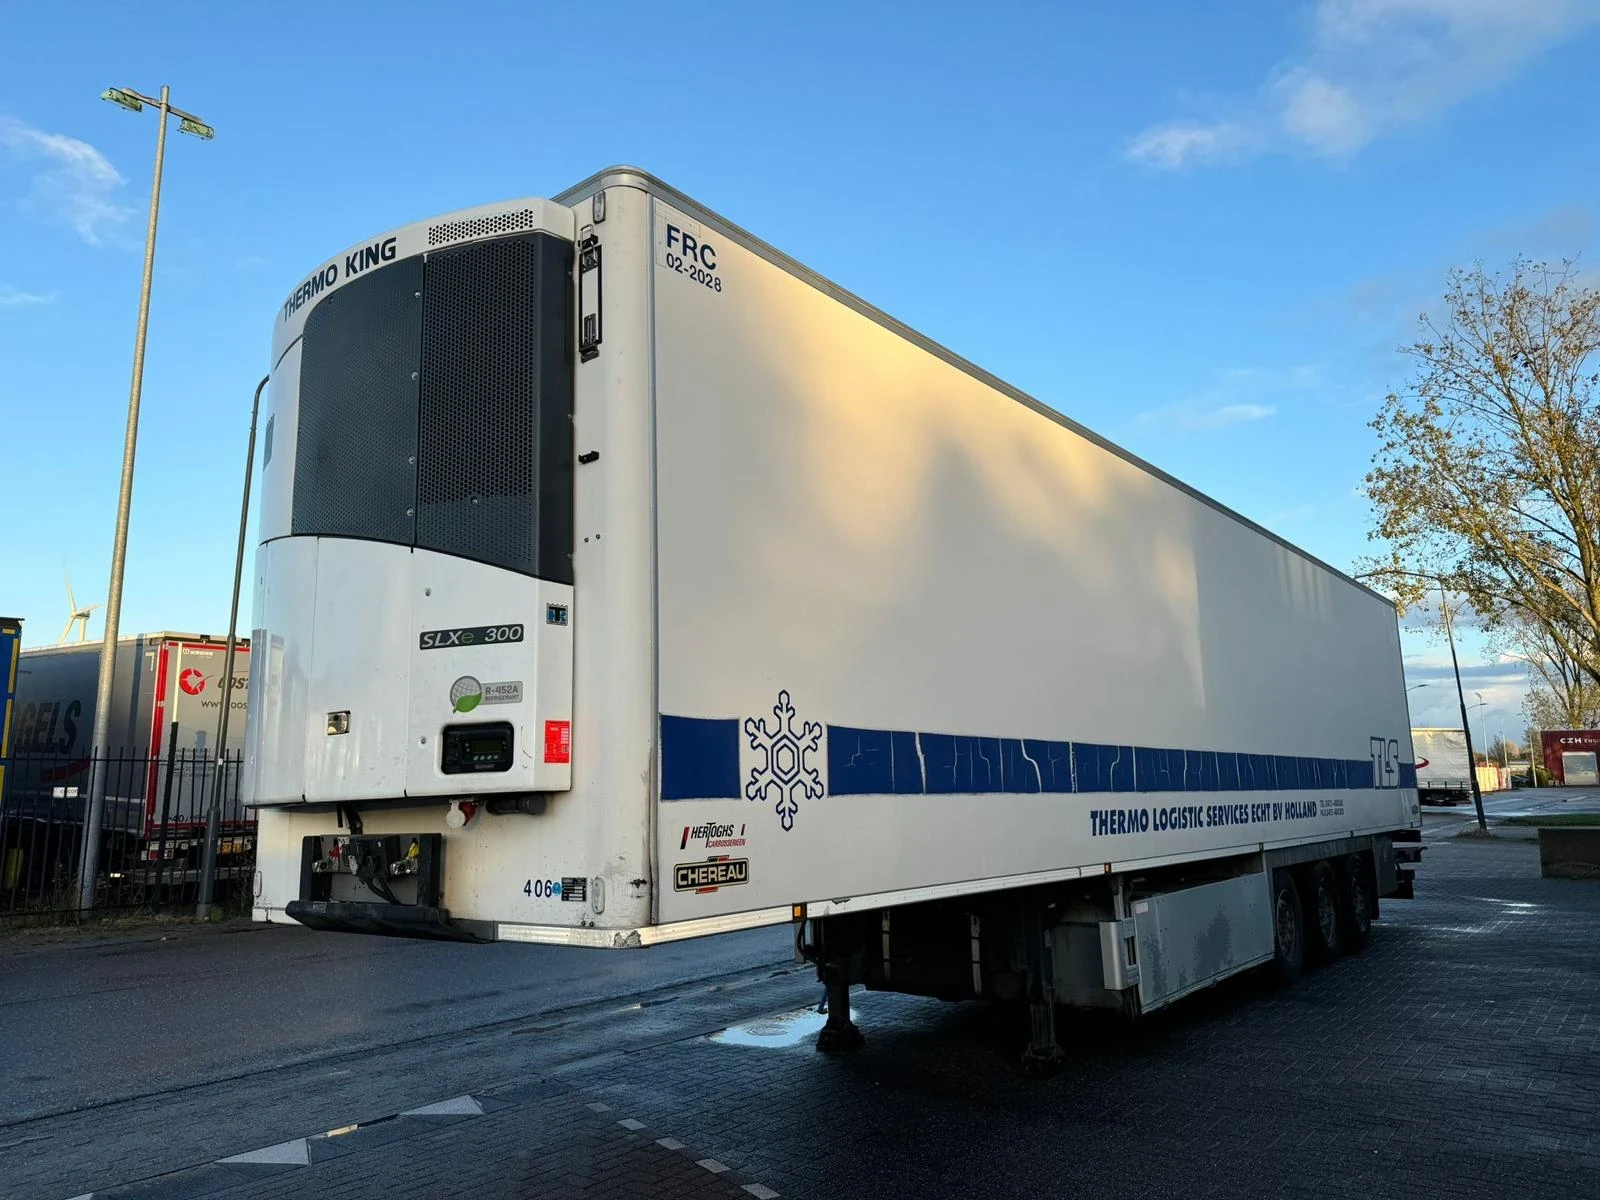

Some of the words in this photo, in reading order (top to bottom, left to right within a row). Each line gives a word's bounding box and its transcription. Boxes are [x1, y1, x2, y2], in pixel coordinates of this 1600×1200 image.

[666, 223, 716, 270] FRC
[284, 264, 338, 322] THERMO
[345, 237, 397, 278] KING
[666, 252, 722, 292] 02-2028
[484, 626, 522, 642] 300
[485, 685, 519, 695] R-452A
[1370, 736, 1399, 789] TLS
[1090, 808, 1149, 836] THERMO
[1153, 806, 1203, 831] LOGISTIC
[1206, 804, 1249, 826] SERVICES
[1251, 803, 1271, 823] ECHT
[1272, 802, 1283, 821] BV
[1285, 801, 1317, 820] HOLLAND
[691, 822, 735, 848] HERTOGHS
[523, 879, 552, 897] 406
[677, 863, 746, 886] CHEREAU
